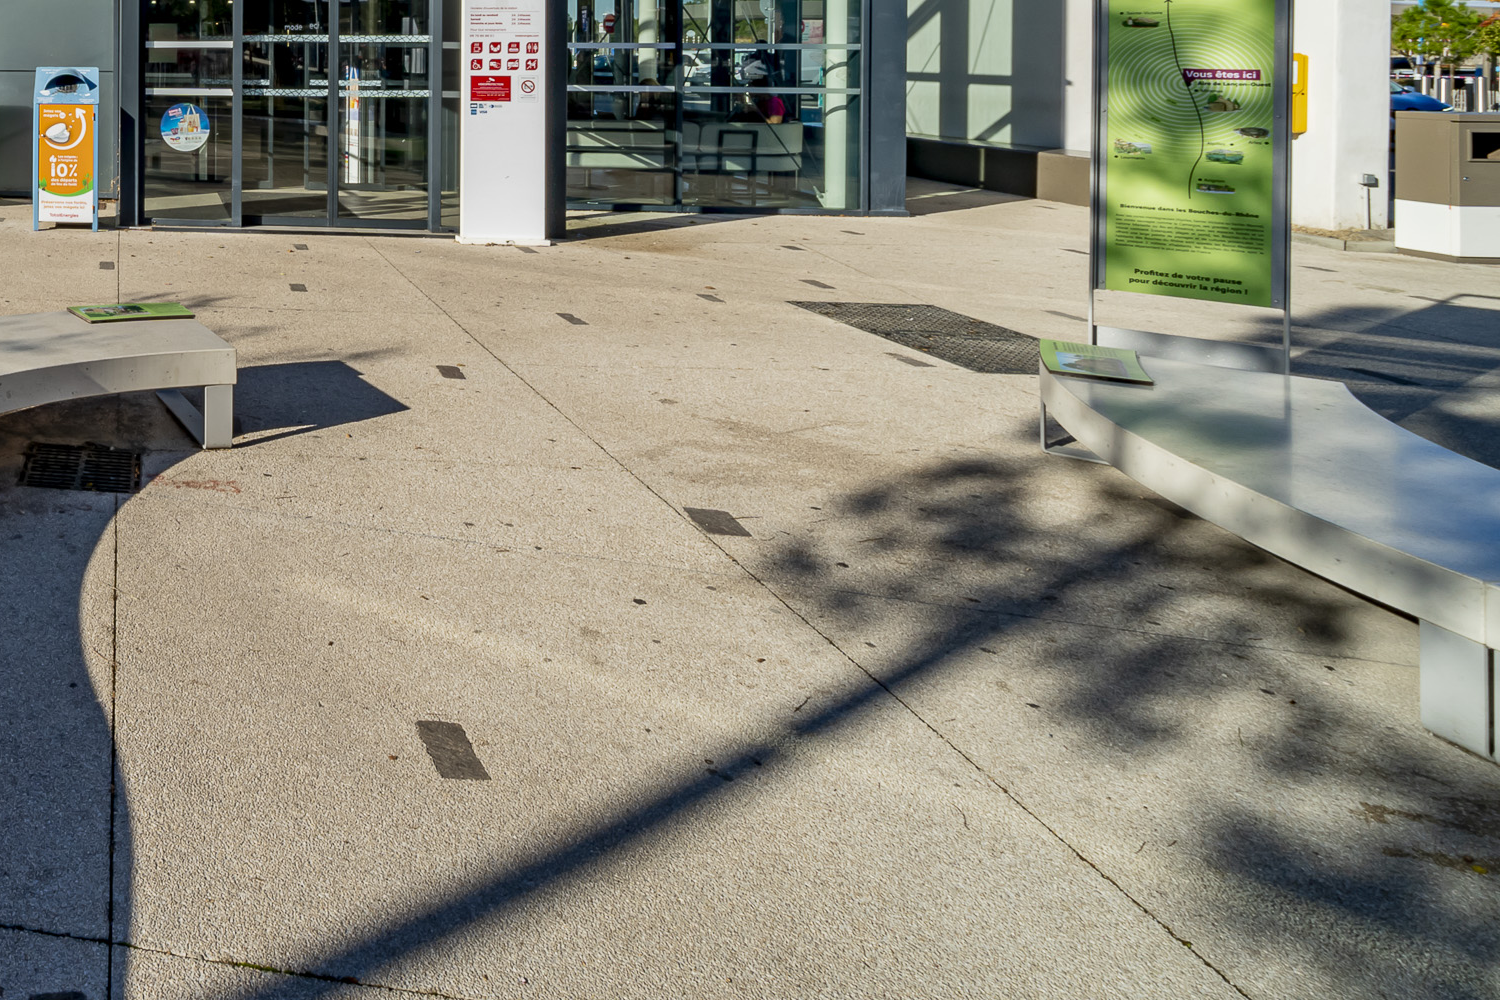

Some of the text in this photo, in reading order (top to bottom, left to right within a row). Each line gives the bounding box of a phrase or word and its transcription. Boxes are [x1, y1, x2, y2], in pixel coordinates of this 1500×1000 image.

[1185, 70, 1257, 79] Vous êtes ici
[50, 162, 78, 177] 10%
[1119, 203, 1156, 211] Bienvenue
[1134, 268, 1169, 278] Profitez
[1213, 277, 1243, 285] pause
[1152, 279, 1197, 290] découvrir
[1210, 285, 1242, 294] région
